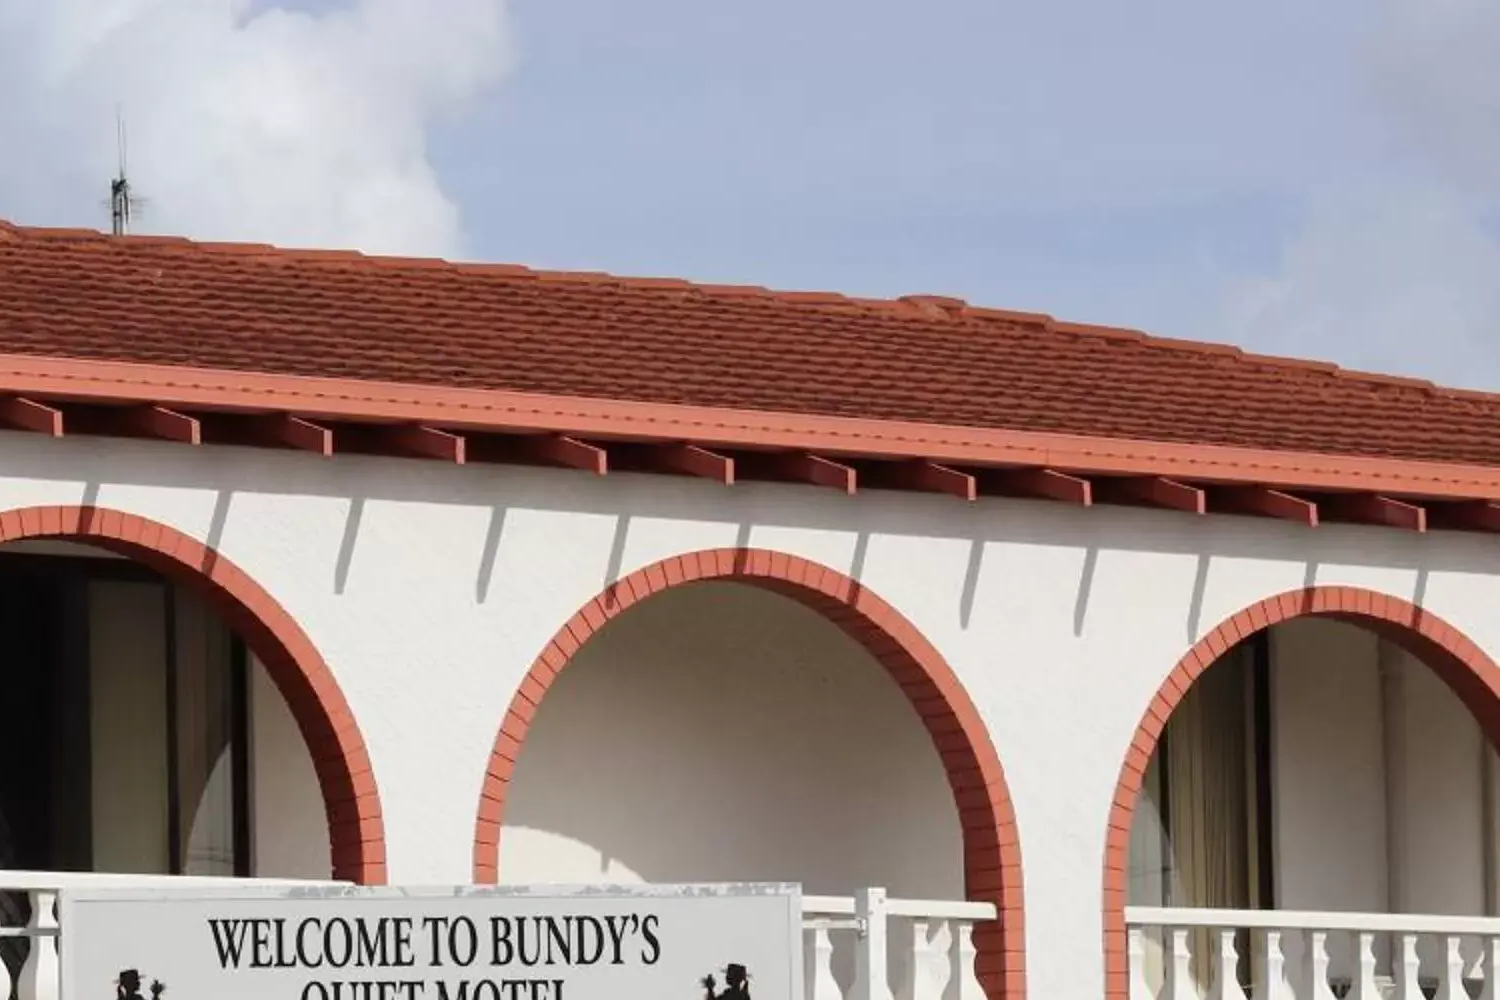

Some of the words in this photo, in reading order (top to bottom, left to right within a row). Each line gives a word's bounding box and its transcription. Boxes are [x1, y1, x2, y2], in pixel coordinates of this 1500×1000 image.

[208, 917, 416, 970] WELCOME
[423, 916, 479, 968] TO
[490, 914, 662, 968] BUNDY'S
